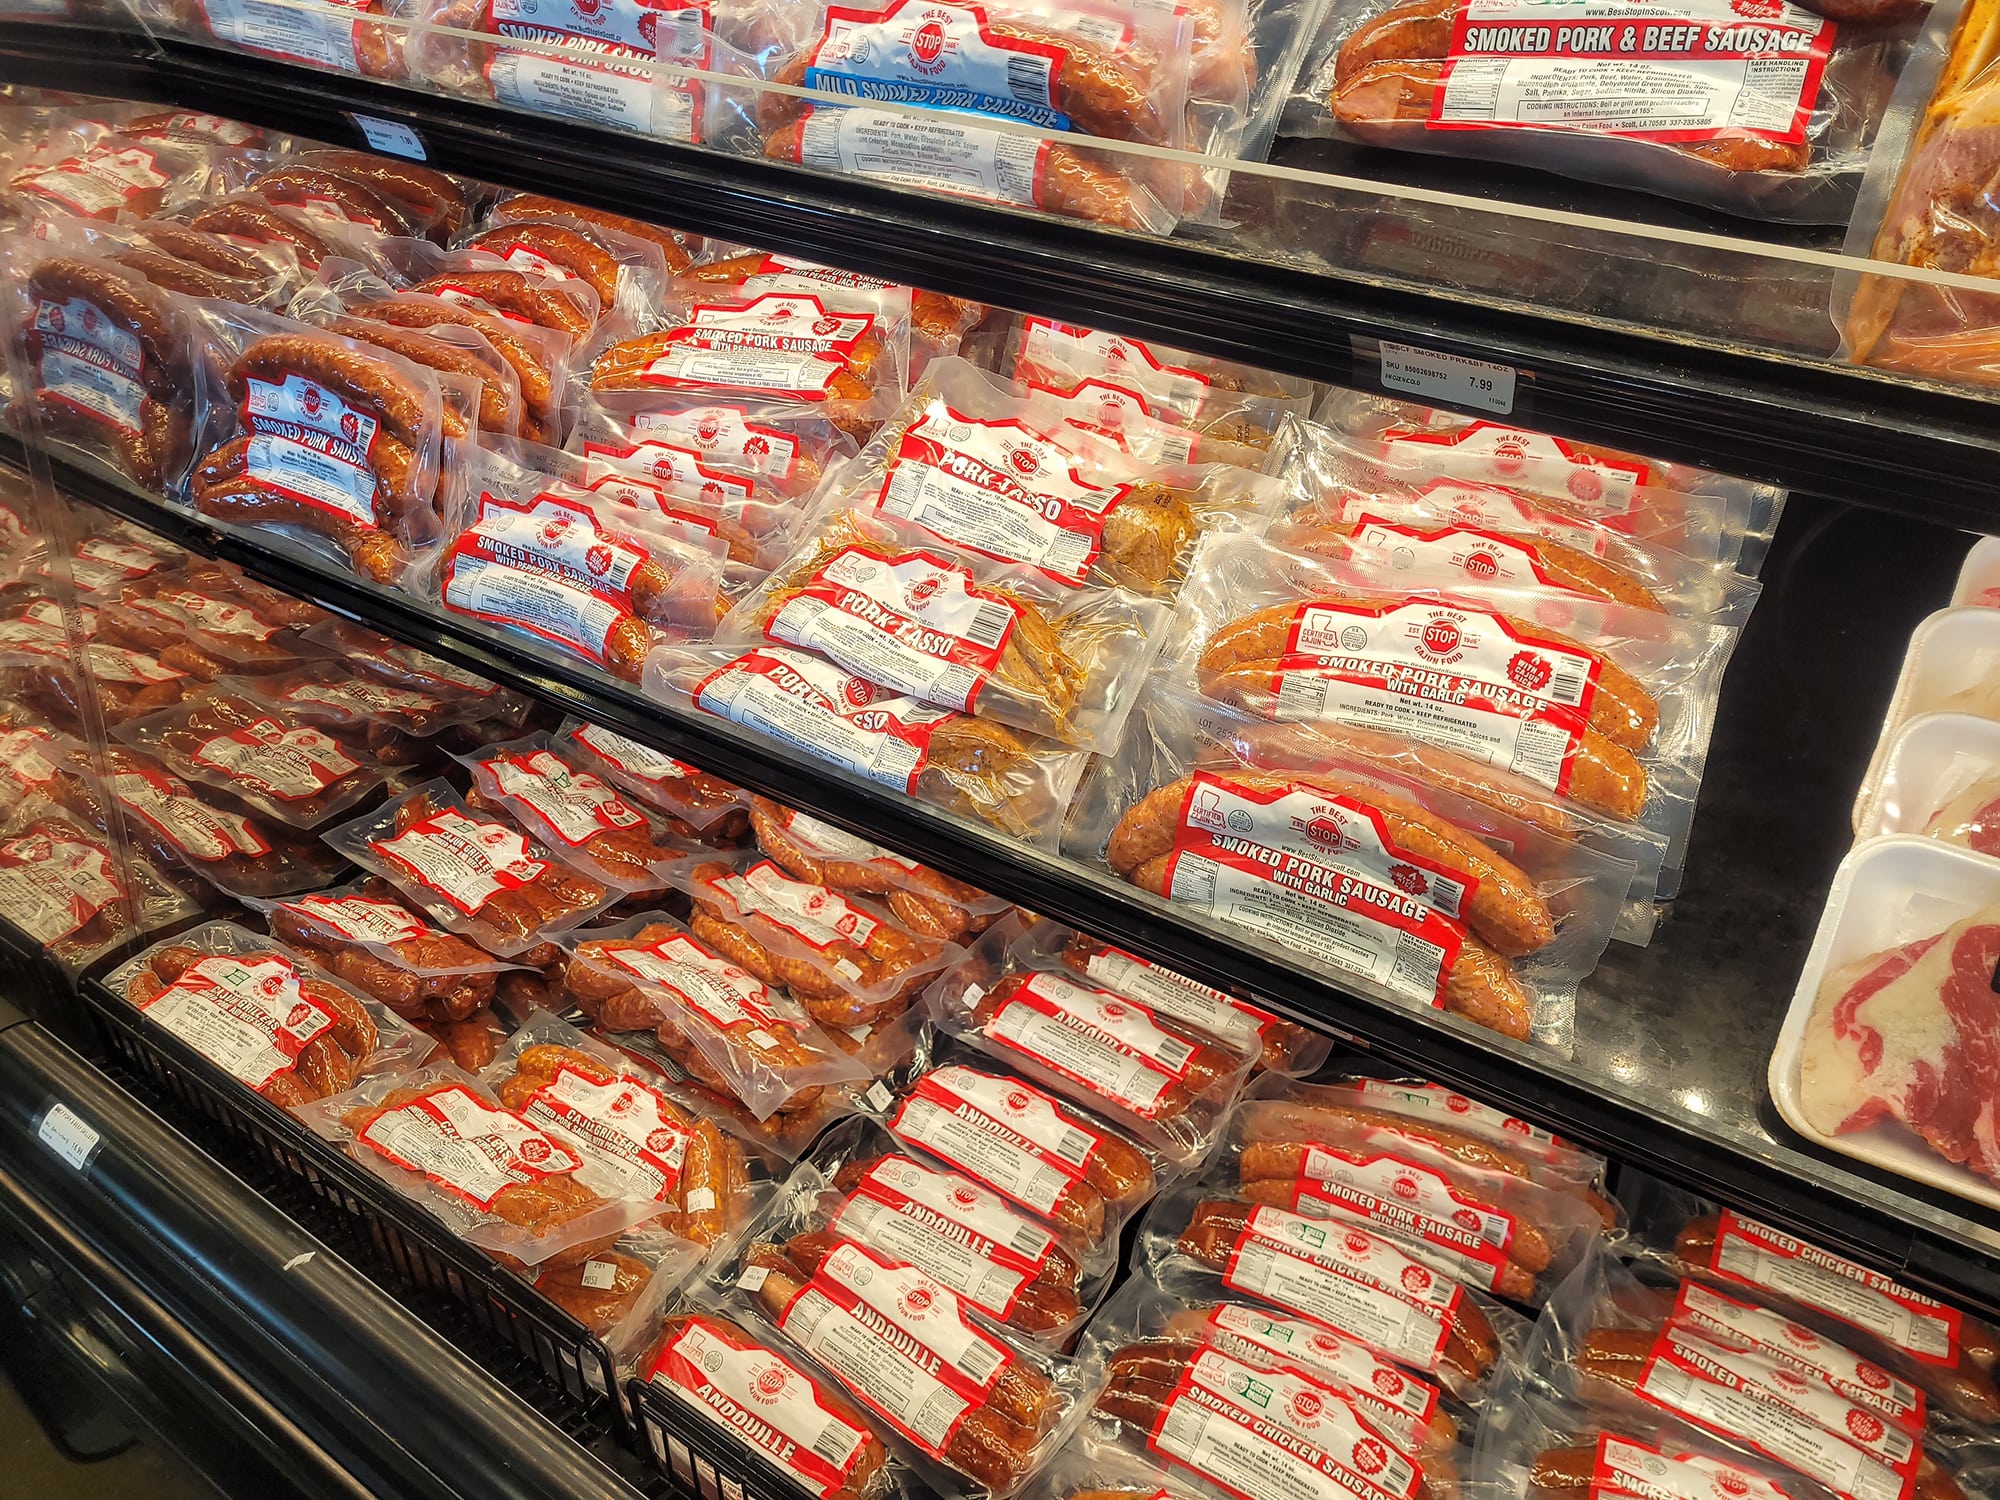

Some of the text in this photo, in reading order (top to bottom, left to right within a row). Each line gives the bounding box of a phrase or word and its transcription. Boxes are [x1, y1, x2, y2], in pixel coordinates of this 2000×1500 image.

[922, 10, 954, 26] THE BEST
[916, 32, 941, 51] STOP
[1464, 26, 1816, 53] SMOKED PORK & BEEF SAUSAGE
[906, 54, 946, 76] CAJUN FOOD
[815, 72, 1059, 129] MILD SMOKED PORK SAUSAGE
[1554, 101, 1599, 109] INSTRUCTIONS:
[694, 328, 832, 352] SMOKED PORK SAUSAGE
[1385, 360, 1400, 370] SKU
[1413, 349, 1447, 361] SMOKED
[1469, 377, 1493, 391] 7.99
[304, 394, 319, 405] STOP
[1100, 393, 1126, 407] THE BEST
[251, 416, 302, 441] SMOKED
[301, 430, 329, 451] PORK
[1496, 434, 1531, 447] THE BEST
[1020, 442, 1034, 451] THE
[1012, 450, 1037, 472] STOP
[654, 466, 672, 479] STOP
[1471, 541, 1505, 559] THE BEST
[477, 535, 612, 596] SMOKED PORK SAUSAGE
[495, 553, 592, 594] WITH PEPPER JACK CHEESE
[1467, 559, 1496, 575] STOP
[916, 583, 936, 595] STOP
[839, 590, 955, 657] PORK TASSO
[1447, 611, 1467, 623] BEST
[1301, 636, 1322, 645] CAJUN
[1303, 628, 1334, 640] CERTIFIED
[1426, 628, 1458, 644] STOP
[1414, 645, 1463, 665] CAJUN FOOD
[1514, 667, 1540, 684] CAJUN
[1518, 659, 1537, 675] WITH
[1318, 656, 1548, 712] SMOKED PORK SAUSAGE
[1514, 674, 1534, 688] KICK
[850, 680, 868, 704] STOP
[1387, 679, 1466, 704] WITH GARLIC
[1400, 697, 1412, 705] Net
[1412, 700, 1423, 708] wt.
[1425, 702, 1434, 710] 14
[1365, 700, 1384, 709] READY
[1394, 706, 1410, 714] COOK
[1416, 710, 1432, 719] KEEP
[1433, 714, 1477, 728] REFRIGERATED
[1193, 806, 1220, 820] CERTIFIED
[1310, 806, 1348, 826] THE BEST
[440, 831, 465, 848] CAJUN
[1309, 826, 1339, 843] STOP
[1281, 845, 1361, 878] www.BestStopInScott.com
[1211, 834, 1428, 922] SMOKED PORK SAUSAGE
[1273, 869, 1348, 906] WITH GARLIC
[1309, 898, 1317, 906] 14
[1318, 902, 1327, 910] oz.
[1052, 1009, 1142, 1059] ANDOUILLE
[1008, 1094, 1027, 1107] STOP
[1448, 1098, 1469, 1108] STOP
[594, 1124, 642, 1155] GRILLERS
[953, 1103, 1044, 1157] ANDOUILLE
[955, 1188, 978, 1201] STOP
[1393, 1181, 1417, 1197] STOP
[1322, 1181, 1482, 1250] SMOKED PORK SAUSAGE
[1369, 1210, 1425, 1239] WITH GARLIC
[900, 1201, 995, 1259] ANDOUILLE
[1251, 1234, 1309, 1262] SMOKED
[1312, 1257, 1376, 1288] CHICKEN
[1736, 1218, 1798, 1252] SMOKED
[1800, 1246, 1867, 1284] CHICKEN
[1869, 1274, 1943, 1310] SAUSAGE
[896, 1297, 927, 1322] CAJUN FOOD
[908, 1290, 931, 1310] STOP
[849, 1301, 944, 1378] ANDOUILLE
[1672, 1343, 1737, 1386] SMOKED
[760, 1374, 784, 1391] STOP
[748, 1381, 779, 1406] CAJUN FOOD
[1295, 1395, 1321, 1412] STOP
[696, 1383, 798, 1462] ANDOUILLE
[1188, 1386, 1322, 1465] SMOKED CHICKEN
[1283, 1404, 1320, 1429] CAJUN FOOD
[1720, 1476, 1747, 1490] STOP
